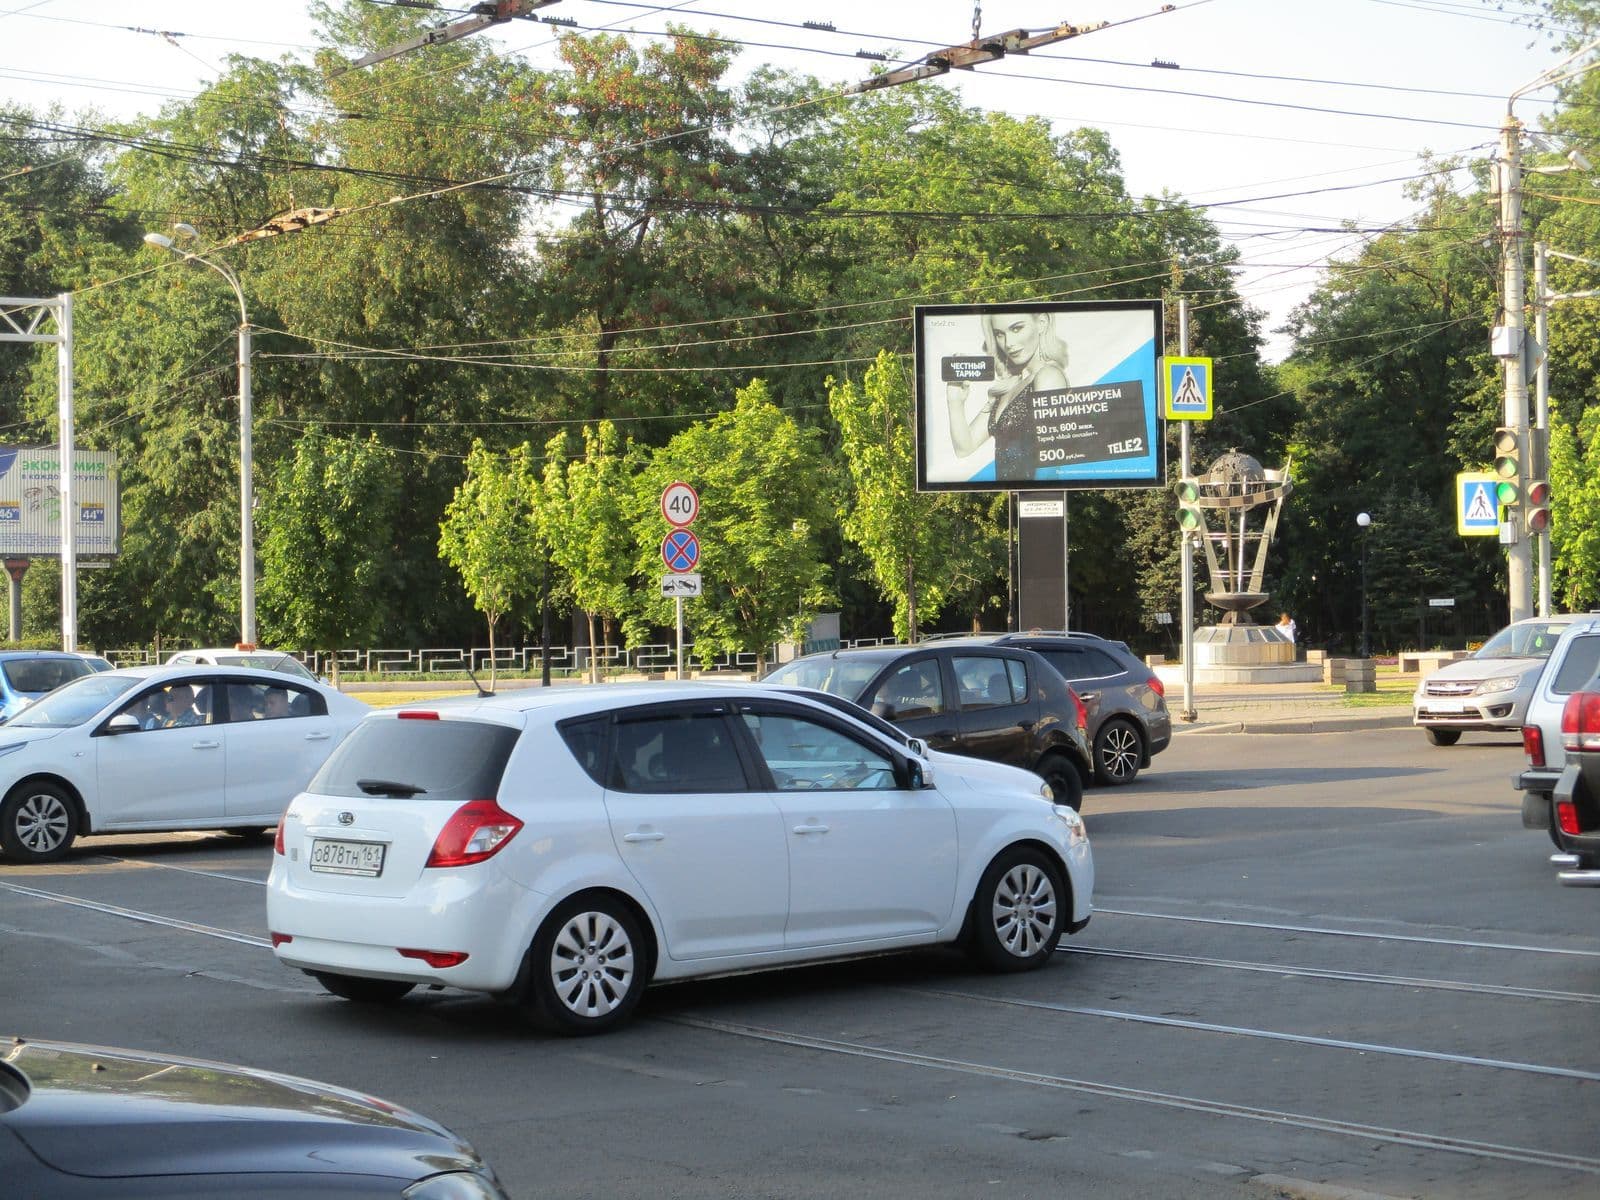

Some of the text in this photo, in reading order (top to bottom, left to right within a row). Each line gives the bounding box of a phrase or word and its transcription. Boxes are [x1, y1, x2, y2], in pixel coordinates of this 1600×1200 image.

[951, 361, 986, 370] ЧЕСТНЫЙ
[955, 370, 981, 378] ТАРИФ
[1032, 388, 1122, 408] НЕ БЛОКИРУЕМ
[1033, 402, 1109, 420] ПРИ МИНУСЕ
[1036, 425, 1048, 435] 30
[1059, 422, 1077, 432] 600
[1107, 437, 1143, 454] TELE2
[1039, 448, 1066, 462] 500
[22, 460, 105, 472] ЭКОНМИЯ
[669, 495, 692, 514] 40
[362, 846, 380, 861] 161
